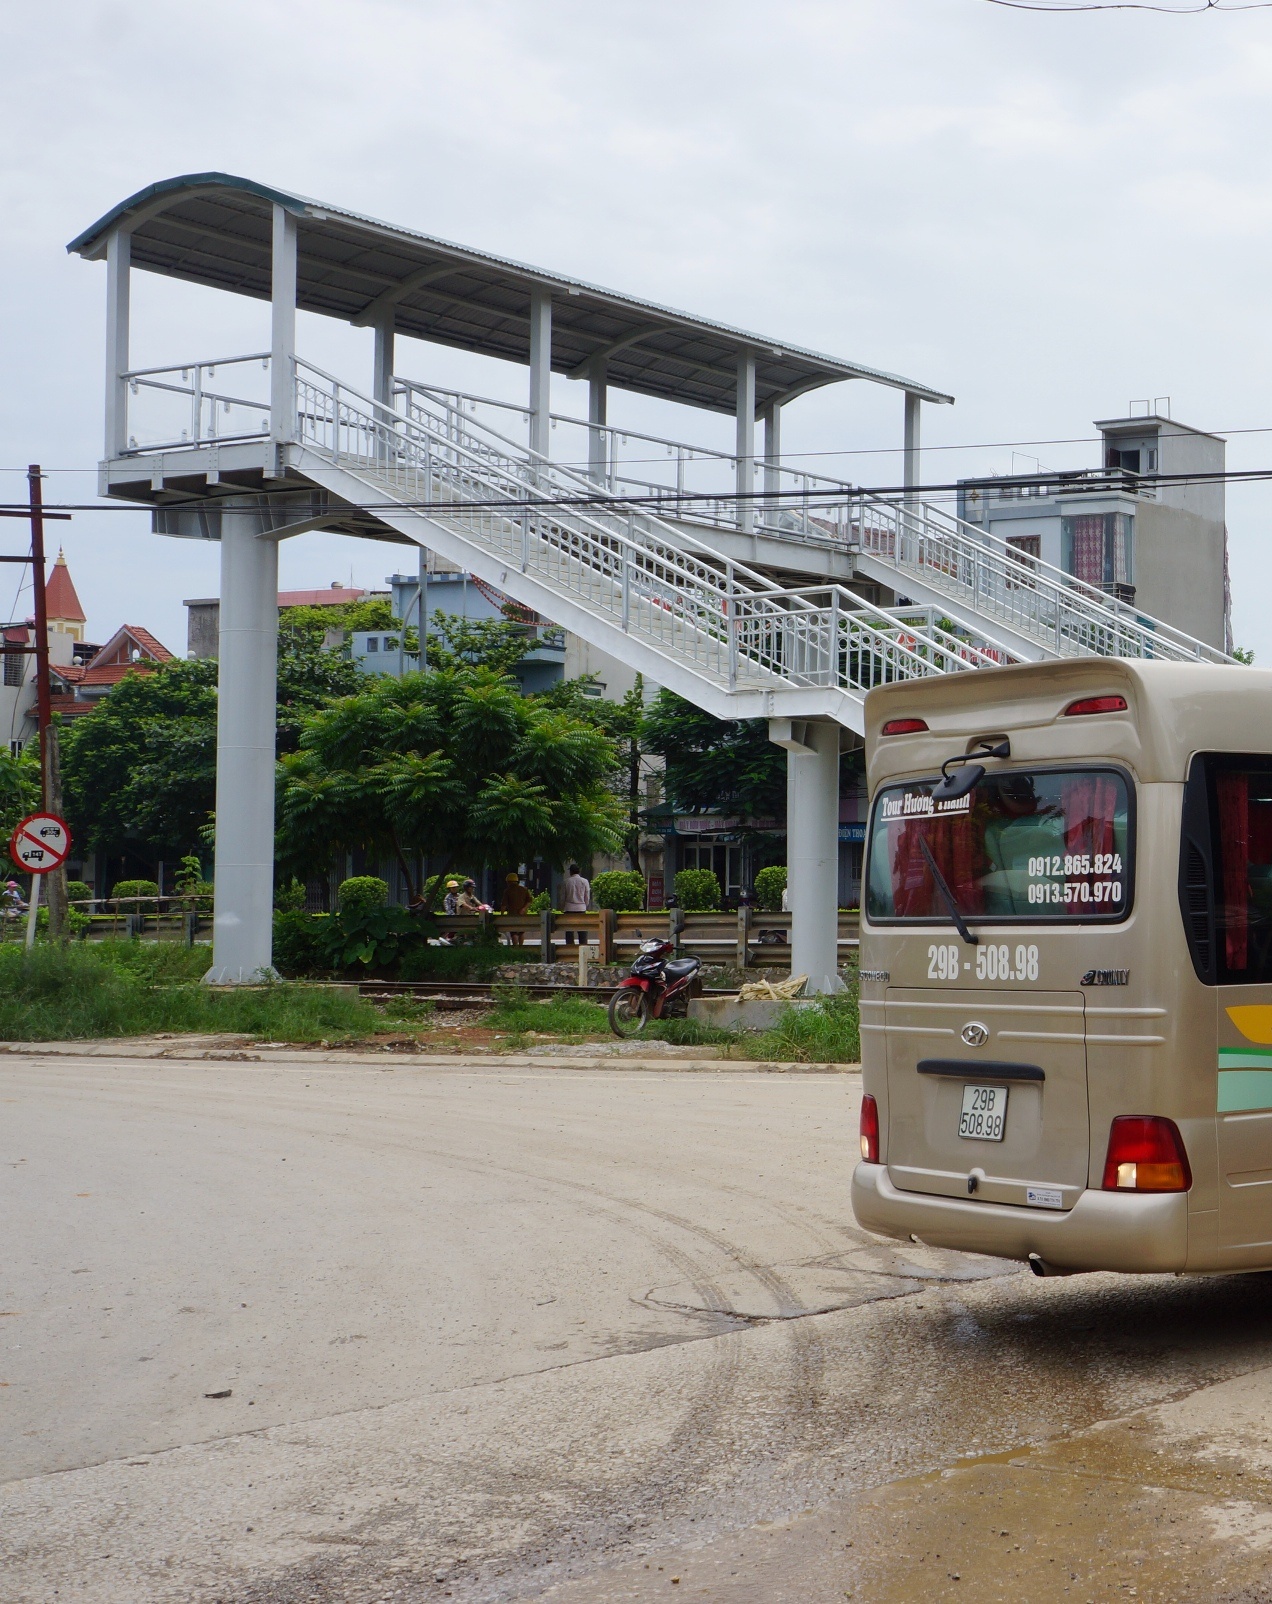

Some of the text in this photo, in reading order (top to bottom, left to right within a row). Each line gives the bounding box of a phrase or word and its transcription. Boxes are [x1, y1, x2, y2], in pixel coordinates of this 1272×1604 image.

[882, 796, 903, 817] Tour
[903, 793, 934, 814] Hương
[1028, 854, 1122, 877] 0912.865.824
[1027, 881, 1122, 904] 0913.570.970
[927, 944, 959, 981] 29B
[975, 944, 1039, 981] 508.98
[971, 1088, 996, 1112] 29B
[960, 1111, 1002, 1138] 508.98
